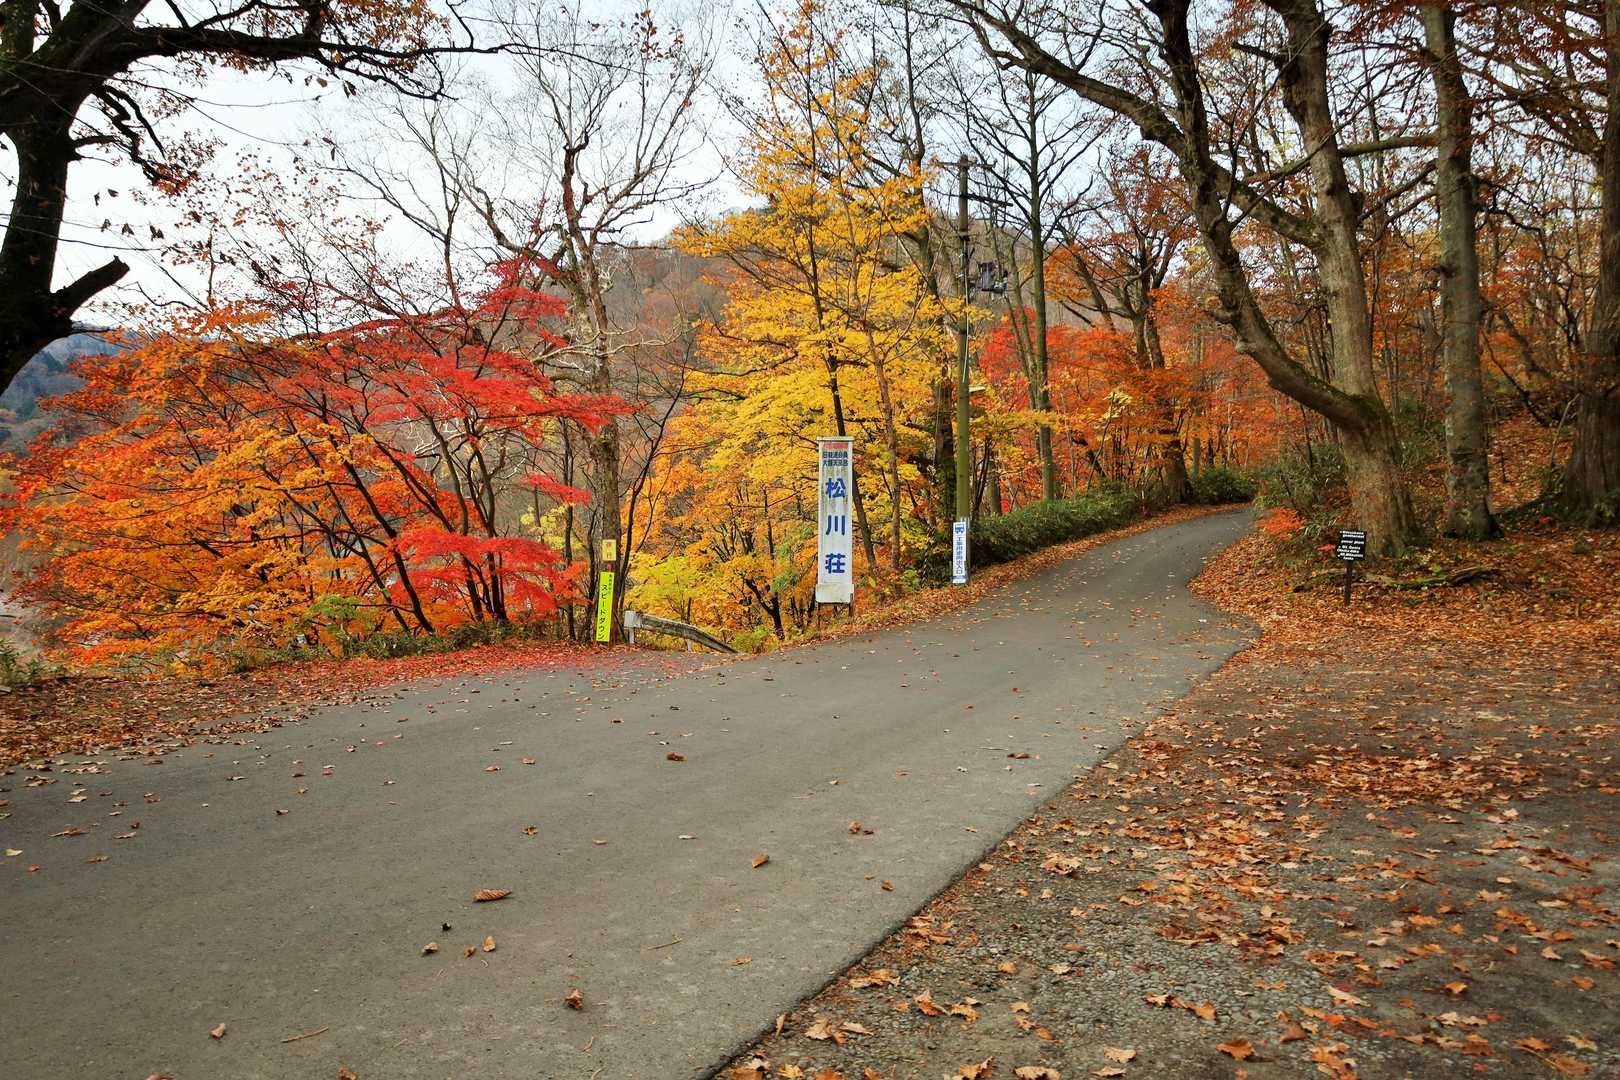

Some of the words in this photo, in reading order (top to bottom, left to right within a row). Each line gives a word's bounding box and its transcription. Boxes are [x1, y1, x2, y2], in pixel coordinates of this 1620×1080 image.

[825, 477, 846, 574] 松川荘
[598, 584, 608, 640] スピードダウン
